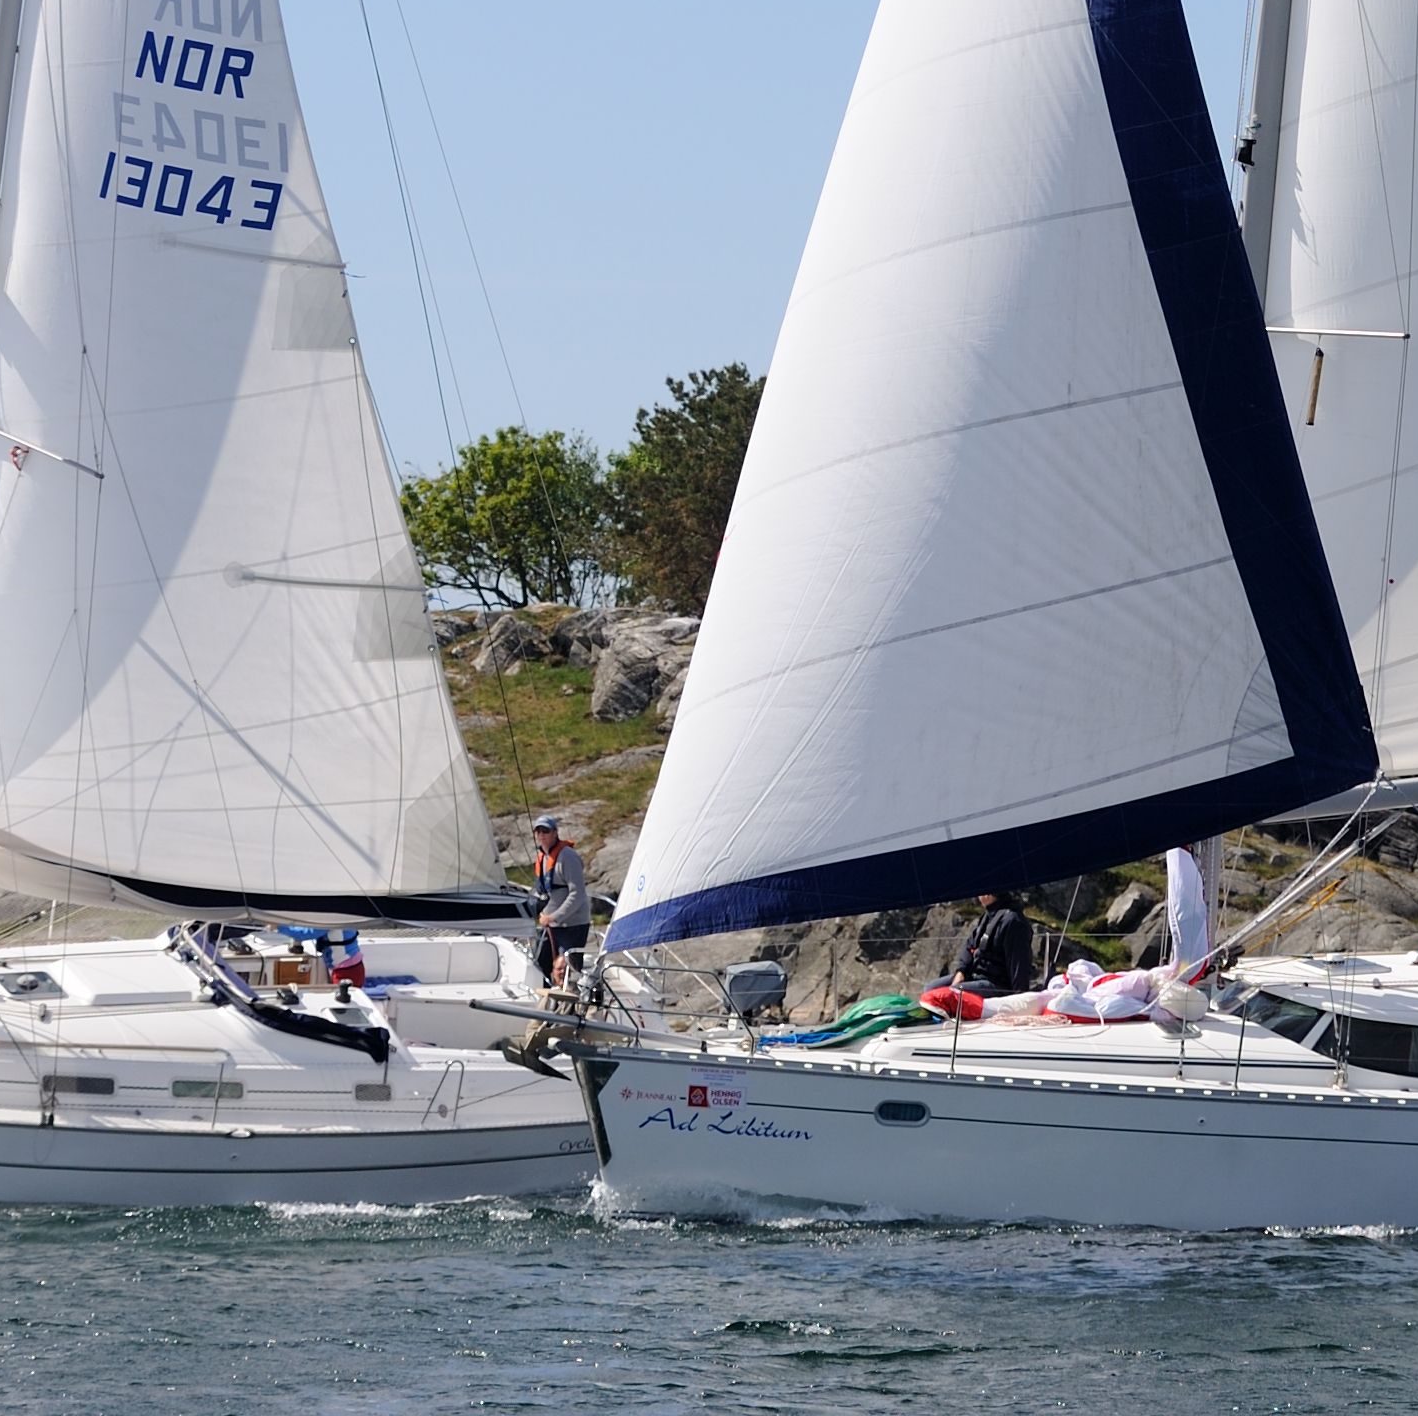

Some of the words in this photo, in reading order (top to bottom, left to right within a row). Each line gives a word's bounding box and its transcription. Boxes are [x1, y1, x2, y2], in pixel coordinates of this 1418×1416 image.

[135, 31, 255, 99] NOR
[99, 151, 283, 231] 13043
[636, 1090, 677, 1101] JEANNEAU
[712, 1098, 740, 1106] OLSEN
[639, 1107, 699, 1132] Ad
[707, 1111, 813, 1140] Libitum
